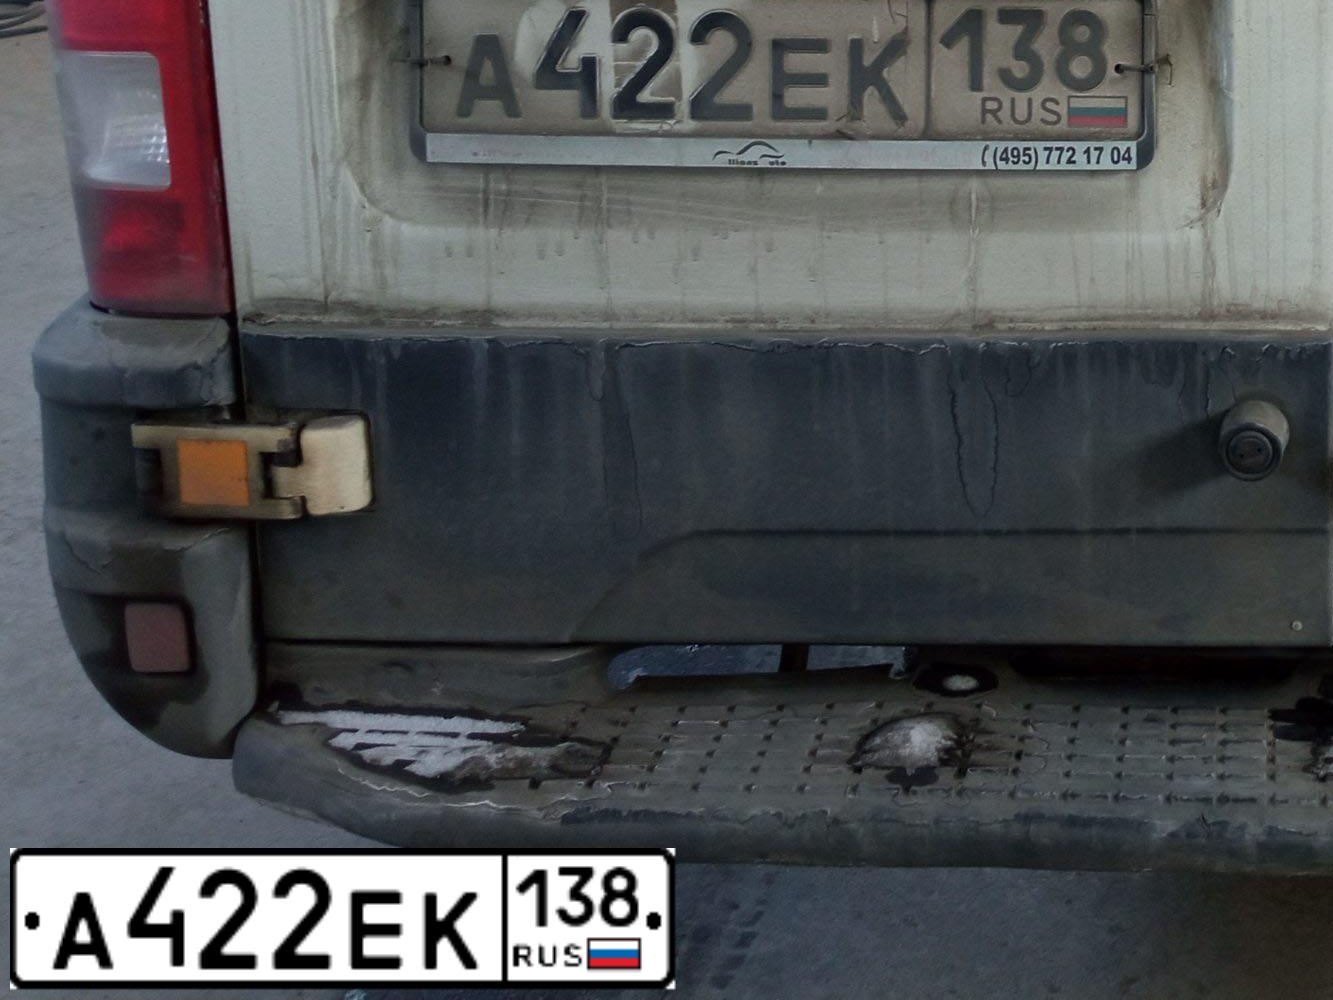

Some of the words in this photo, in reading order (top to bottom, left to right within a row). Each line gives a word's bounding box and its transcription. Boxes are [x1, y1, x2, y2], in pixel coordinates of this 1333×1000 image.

[456, 5, 909, 126] A422EK
[938, 6, 1110, 93] 138
[980, 96, 1063, 127] RUS
[992, 146, 1039, 171] (495)
[1043, 146, 1077, 165] 772
[1082, 147, 1104, 165] 17
[1110, 146, 1133, 165] 04
